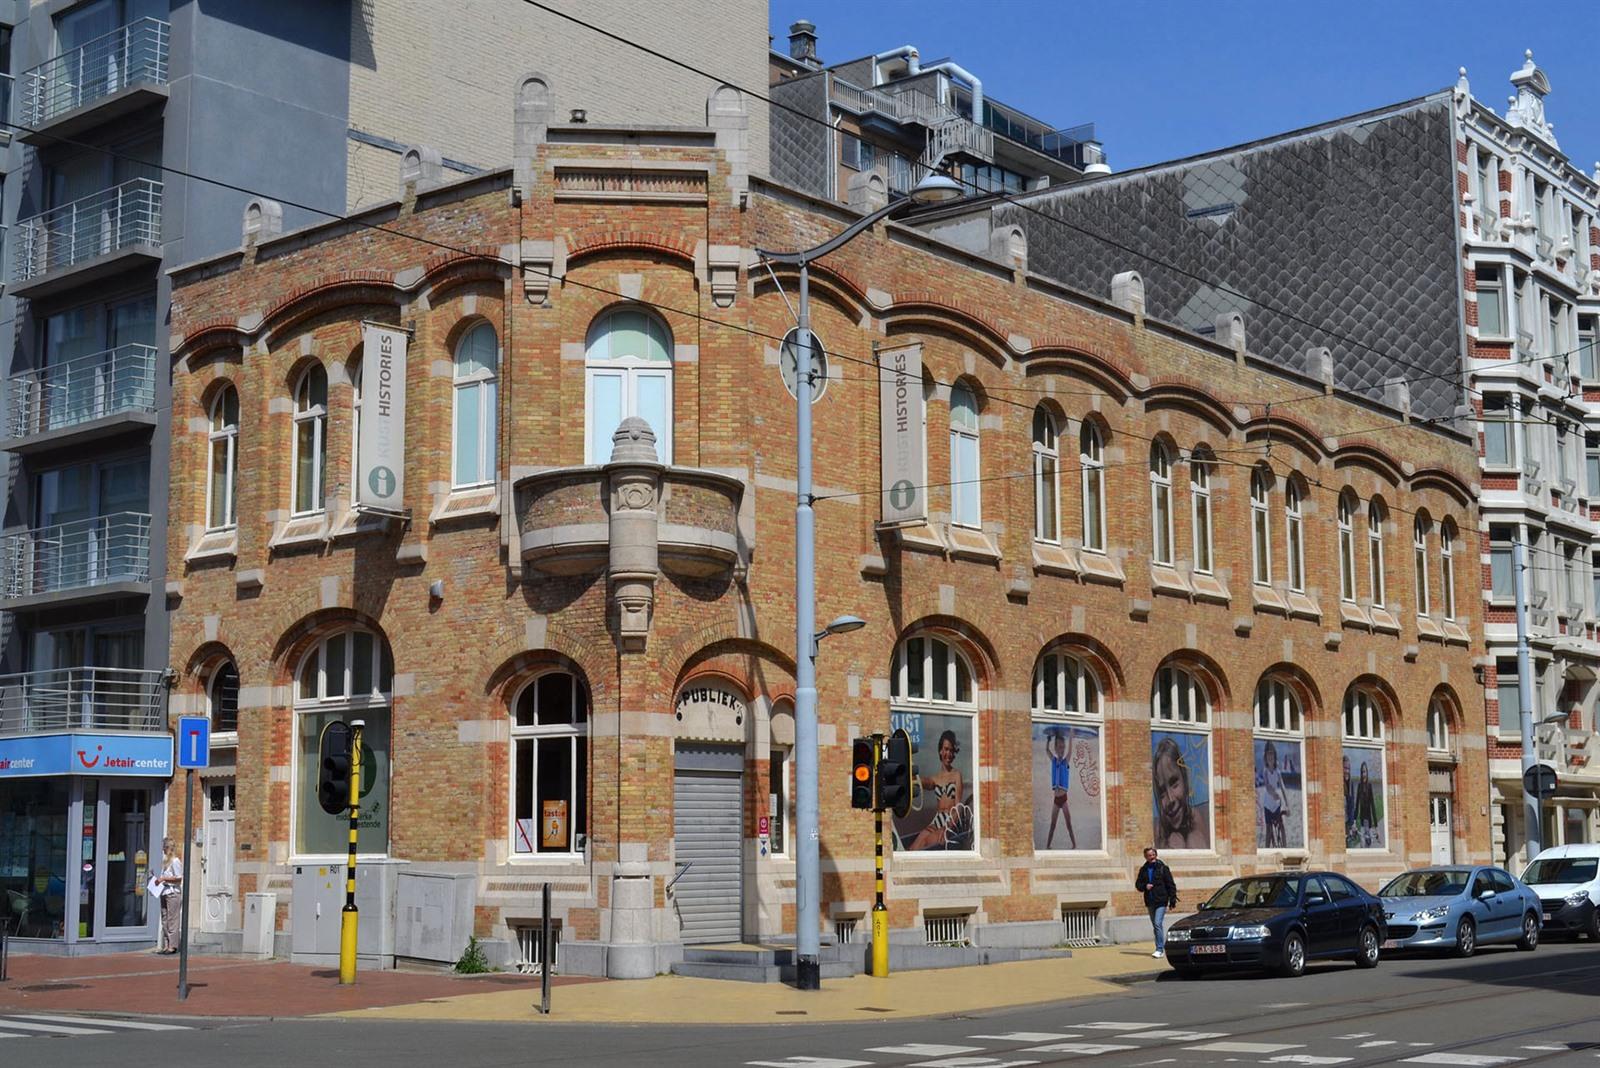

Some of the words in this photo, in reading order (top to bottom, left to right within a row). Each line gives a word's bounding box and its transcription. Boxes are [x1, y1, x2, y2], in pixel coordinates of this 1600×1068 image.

[379, 335, 392, 417] HISTORIES
[682, 687, 737, 710] PUBLIEK
[104, 756, 169, 769] Jetaircenter
